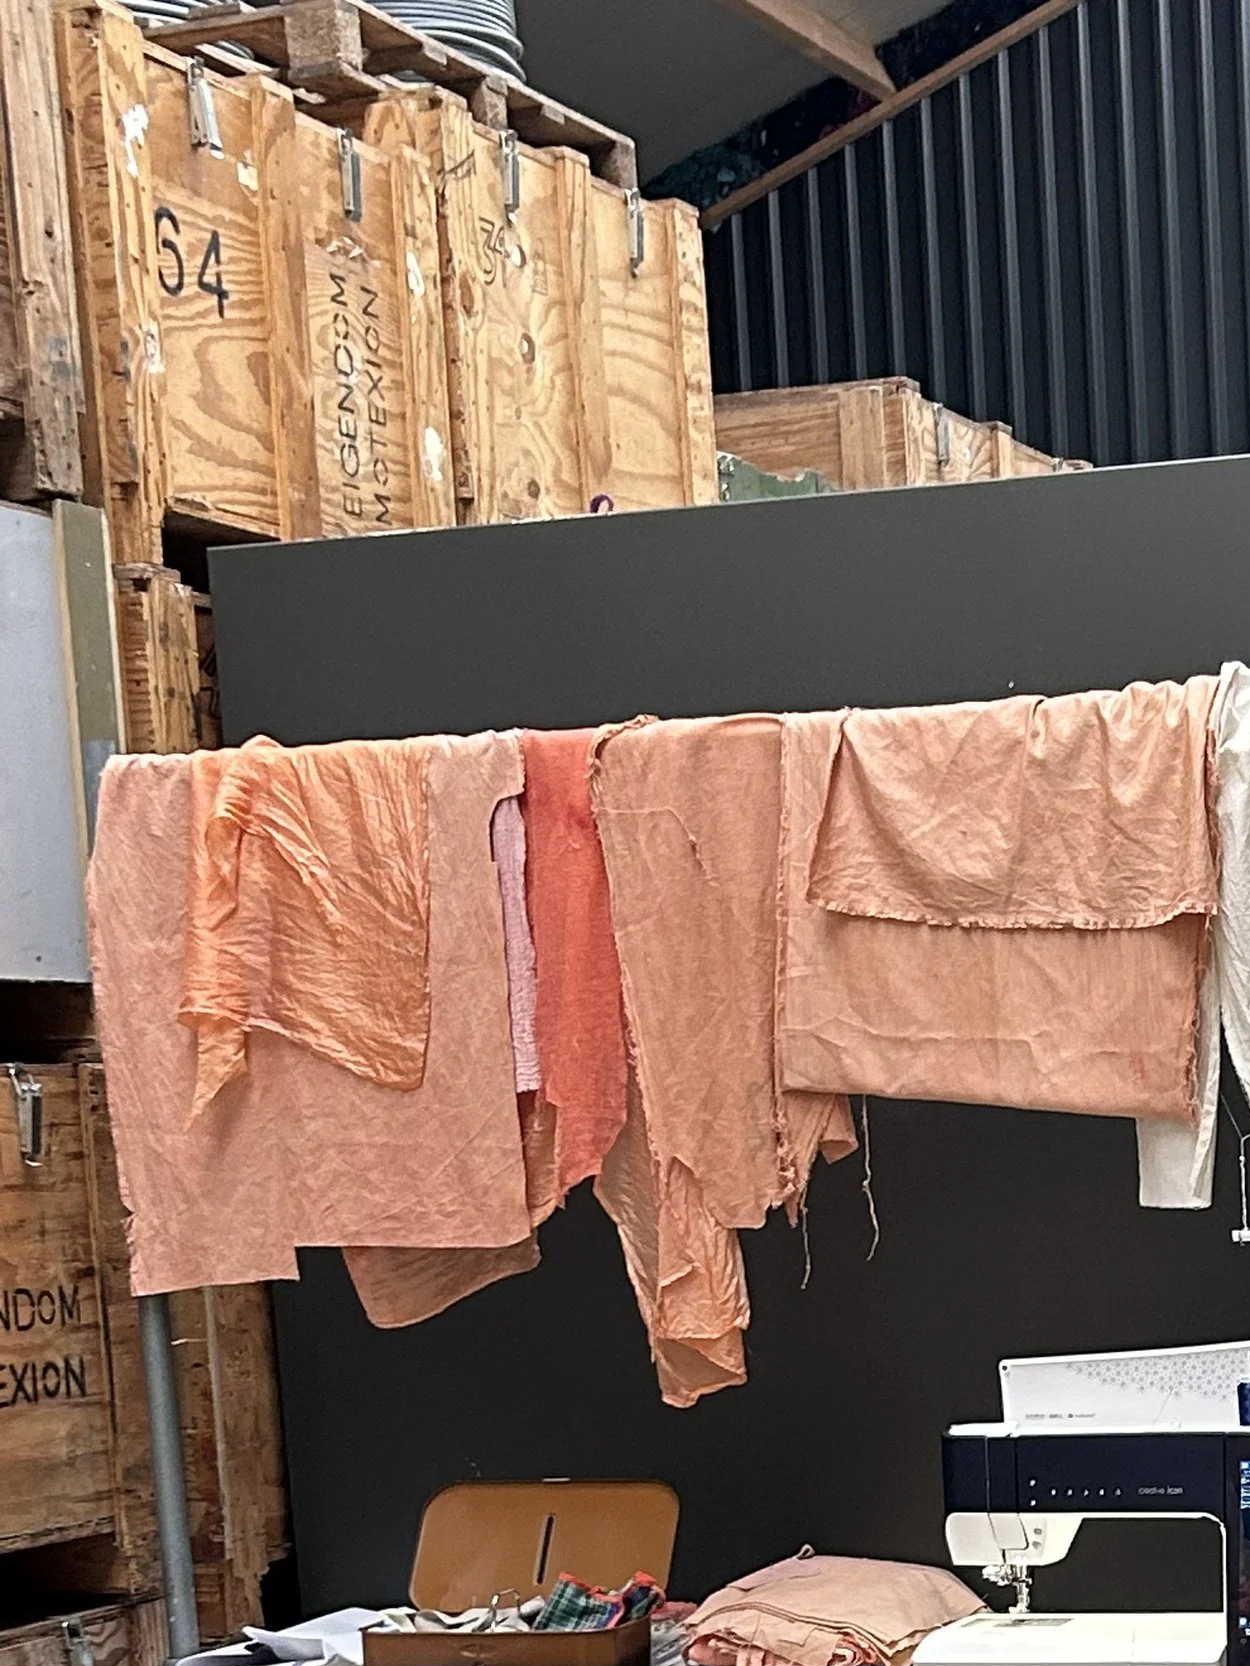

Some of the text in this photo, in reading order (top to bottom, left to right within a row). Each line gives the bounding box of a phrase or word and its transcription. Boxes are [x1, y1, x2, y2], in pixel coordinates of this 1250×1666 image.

[155, 206, 230, 319] 64
[329, 273, 362, 518] EIGENDOM
[360, 286, 392, 526] MOTEXION
